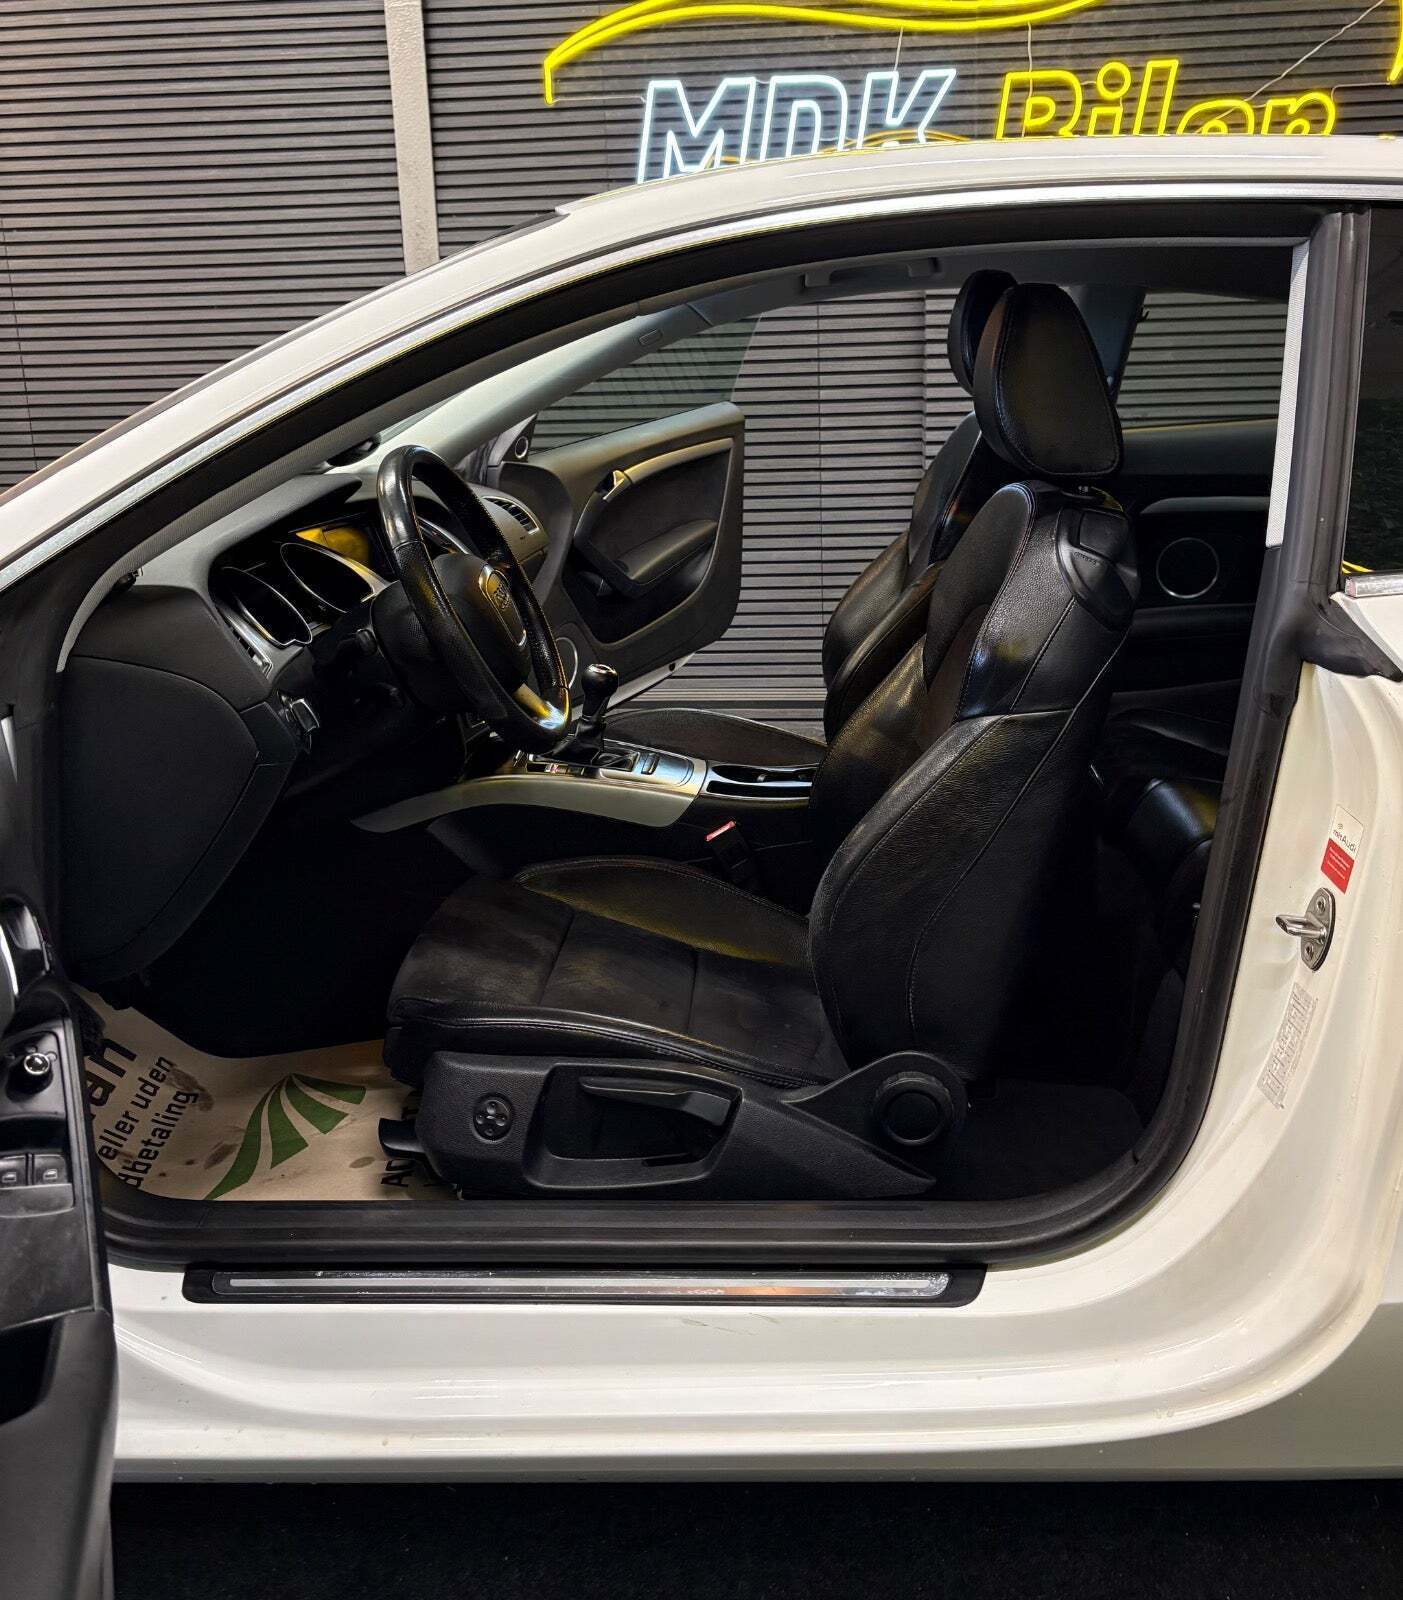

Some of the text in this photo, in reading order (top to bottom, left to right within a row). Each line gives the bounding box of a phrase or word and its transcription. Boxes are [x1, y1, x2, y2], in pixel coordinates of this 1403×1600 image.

[636, 69, 957, 185] MDK
[98, 1056, 174, 1161] eller uden
[118, 1091, 199, 1188] dbetaling
